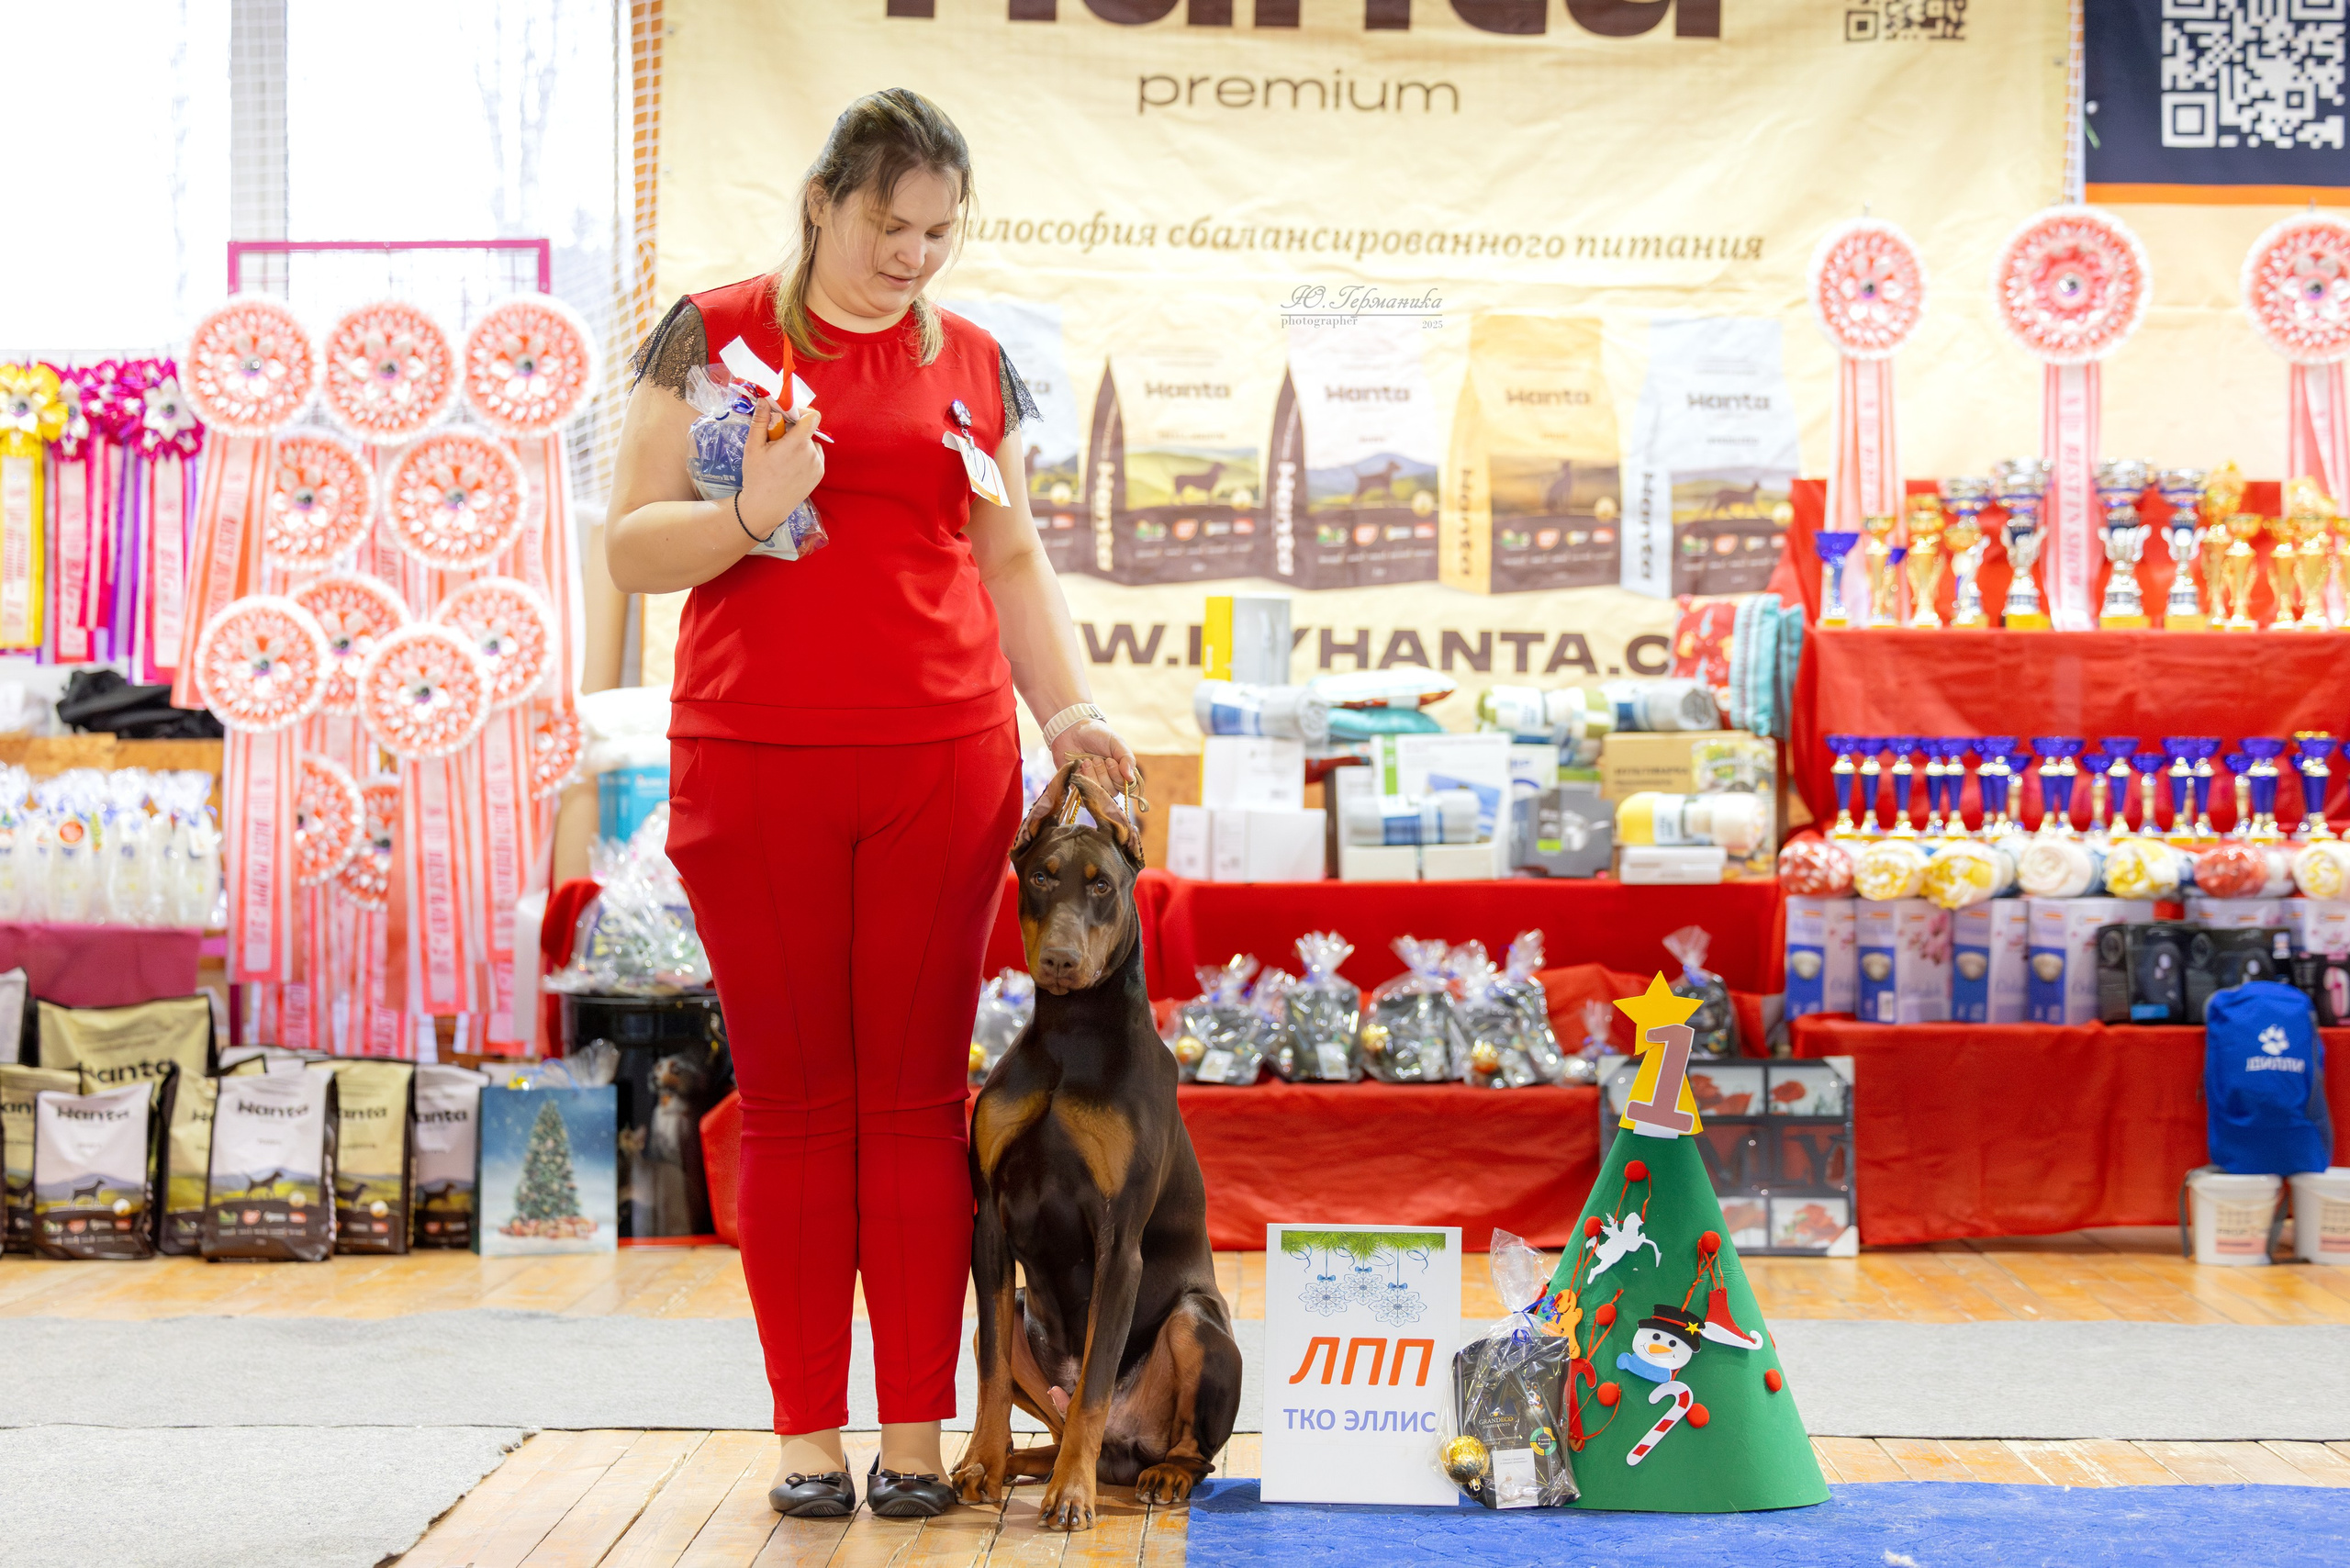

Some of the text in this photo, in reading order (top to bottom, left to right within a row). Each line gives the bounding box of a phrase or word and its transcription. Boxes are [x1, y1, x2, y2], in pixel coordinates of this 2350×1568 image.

[1138, 69, 1460, 116] premium
[967, 210, 1765, 261] илософия сбалансированного питания
[88, 1058, 173, 1083] anta
[1625, 1023, 1695, 1134] 1
[339, 1106, 387, 1119] anta
[416, 1109, 468, 1124] anta
[1289, 1337, 1435, 1386] ЛПП
[1283, 1408, 1436, 1432] ТКО ЭЛЛИС
[1479, 1416, 1514, 1425] GRANDECO
